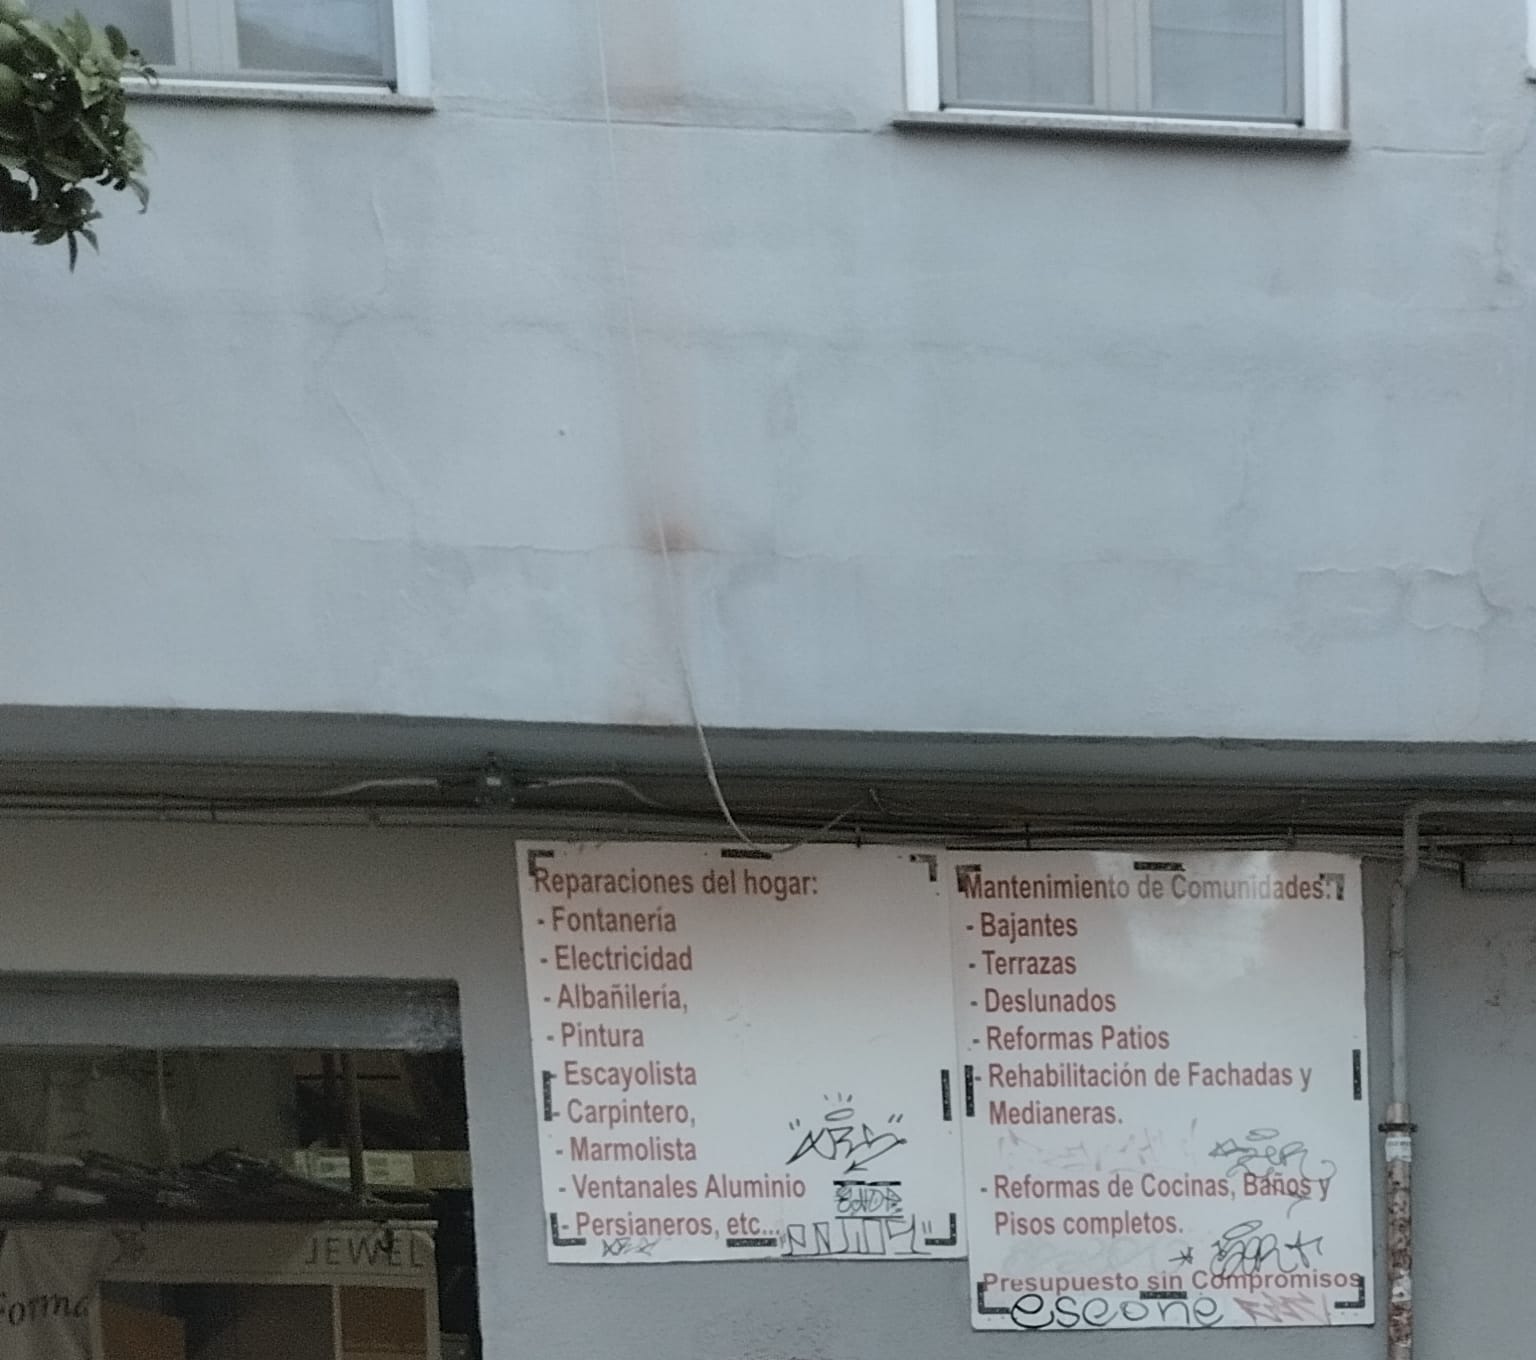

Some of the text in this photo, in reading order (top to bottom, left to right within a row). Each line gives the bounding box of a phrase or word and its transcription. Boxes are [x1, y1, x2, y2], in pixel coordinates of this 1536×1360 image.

[534, 867, 819, 901] Reparaciones del hogar:
[964, 873, 1332, 900] Mantenimiento de Comunidades:
[551, 904, 678, 932] Fontanería
[980, 911, 1079, 944] Bajantes
[554, 943, 693, 972] Electricidad
[981, 949, 1078, 975] Terrazas
[556, 982, 689, 1014] Albañilería,
[984, 986, 1117, 1013] Deslunados
[560, 1021, 645, 1048] Pintura
[986, 1024, 1171, 1051] Reformas Patios
[563, 1060, 698, 1092] Escayolista
[988, 1061, 1313, 1093] Rehabilitación de Fachadas y
[566, 1097, 696, 1130] Carpintero,
[988, 1099, 1124, 1126] Medianeras.
[569, 1136, 698, 1162] Marmolista
[571, 1172, 807, 1199] Ventanales Aluminio
[993, 1171, 1331, 1202] Reformas de Cocinas, Baños y
[575, 1210, 721, 1241] Persianeros,
[994, 1208, 1185, 1240] Pisos completos.
[304, 1236, 424, 1268] JEWEL
[983, 1267, 1363, 1297] Presupuesto sin Compromisos
